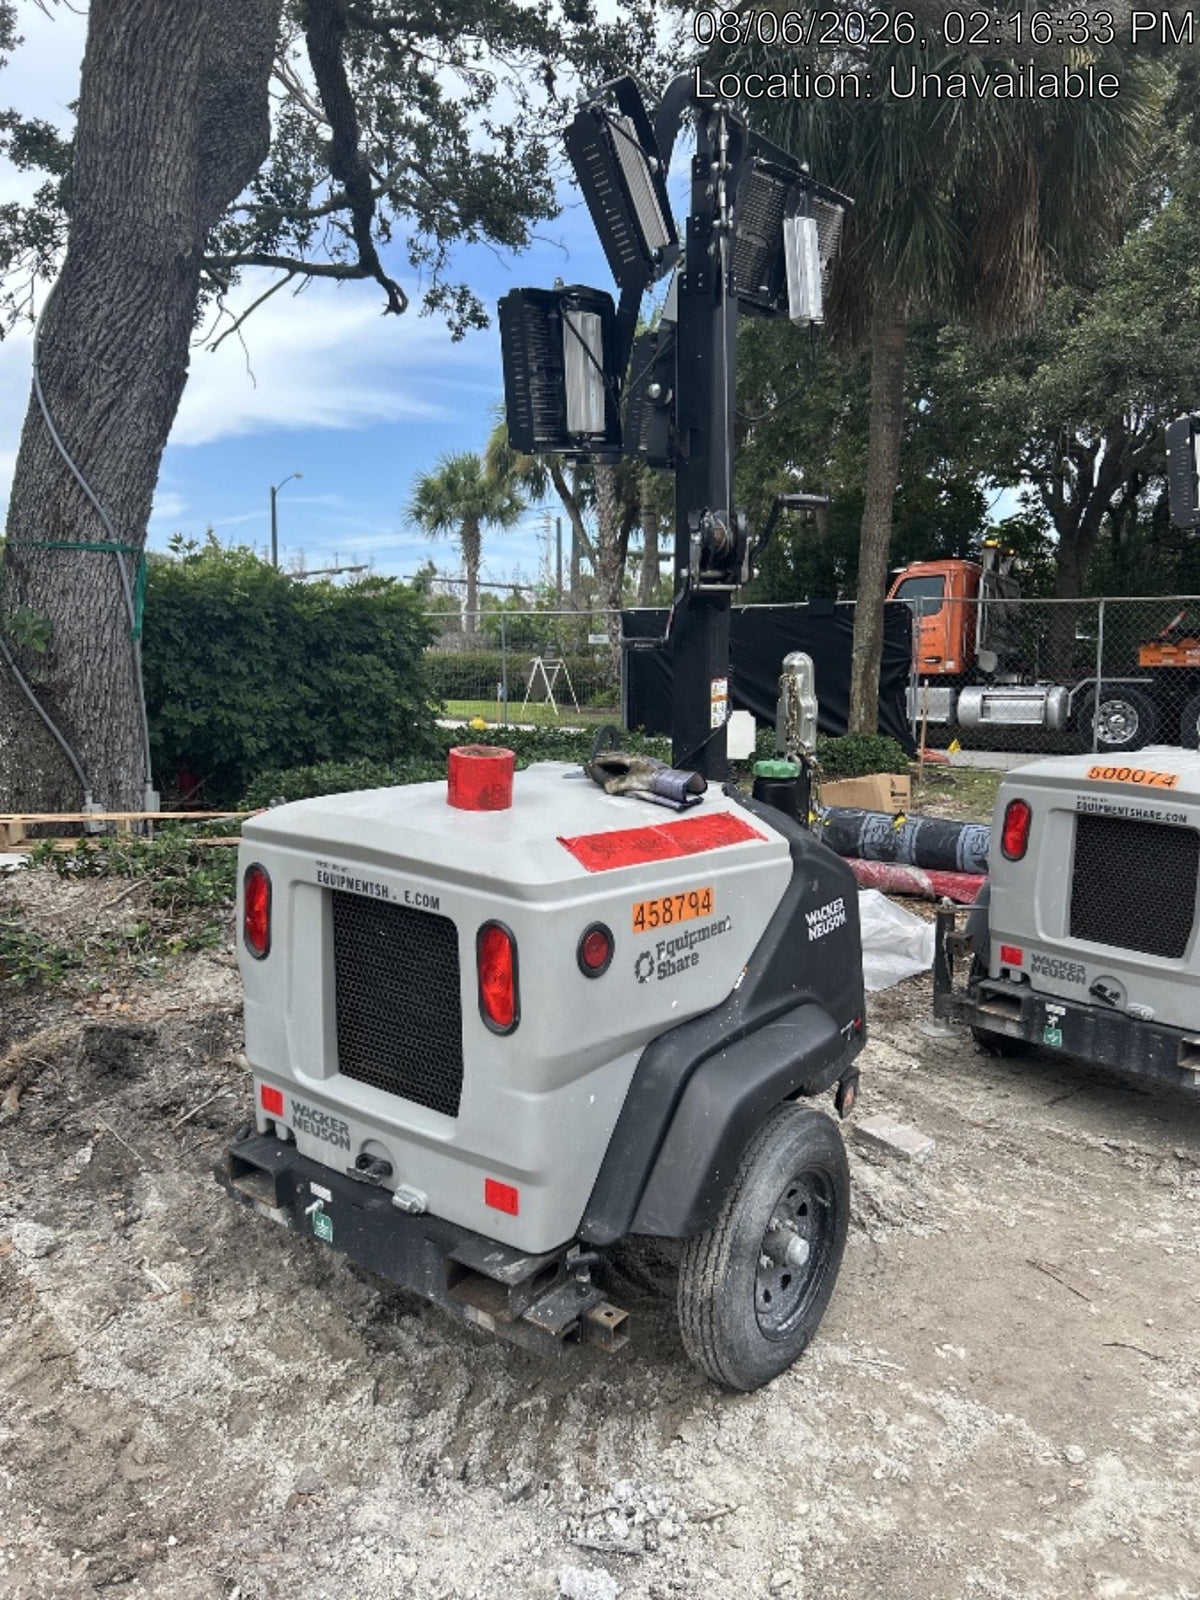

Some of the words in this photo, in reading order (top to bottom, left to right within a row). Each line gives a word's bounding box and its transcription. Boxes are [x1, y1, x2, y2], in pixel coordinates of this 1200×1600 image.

[1088, 767, 1177, 788] 500074
[317, 870, 440, 910] EQUIPMENTSHE.COM
[634, 888, 712, 931] 458794
[805, 897, 845, 926] WACKER
[808, 910, 846, 941] NEUSON
[657, 952, 700, 981] Share
[1031, 954, 1086, 975] WACKER
[1031, 964, 1087, 985] NEUSON
[291, 1100, 350, 1136] WACKER
[292, 1115, 351, 1151] NEUSON
